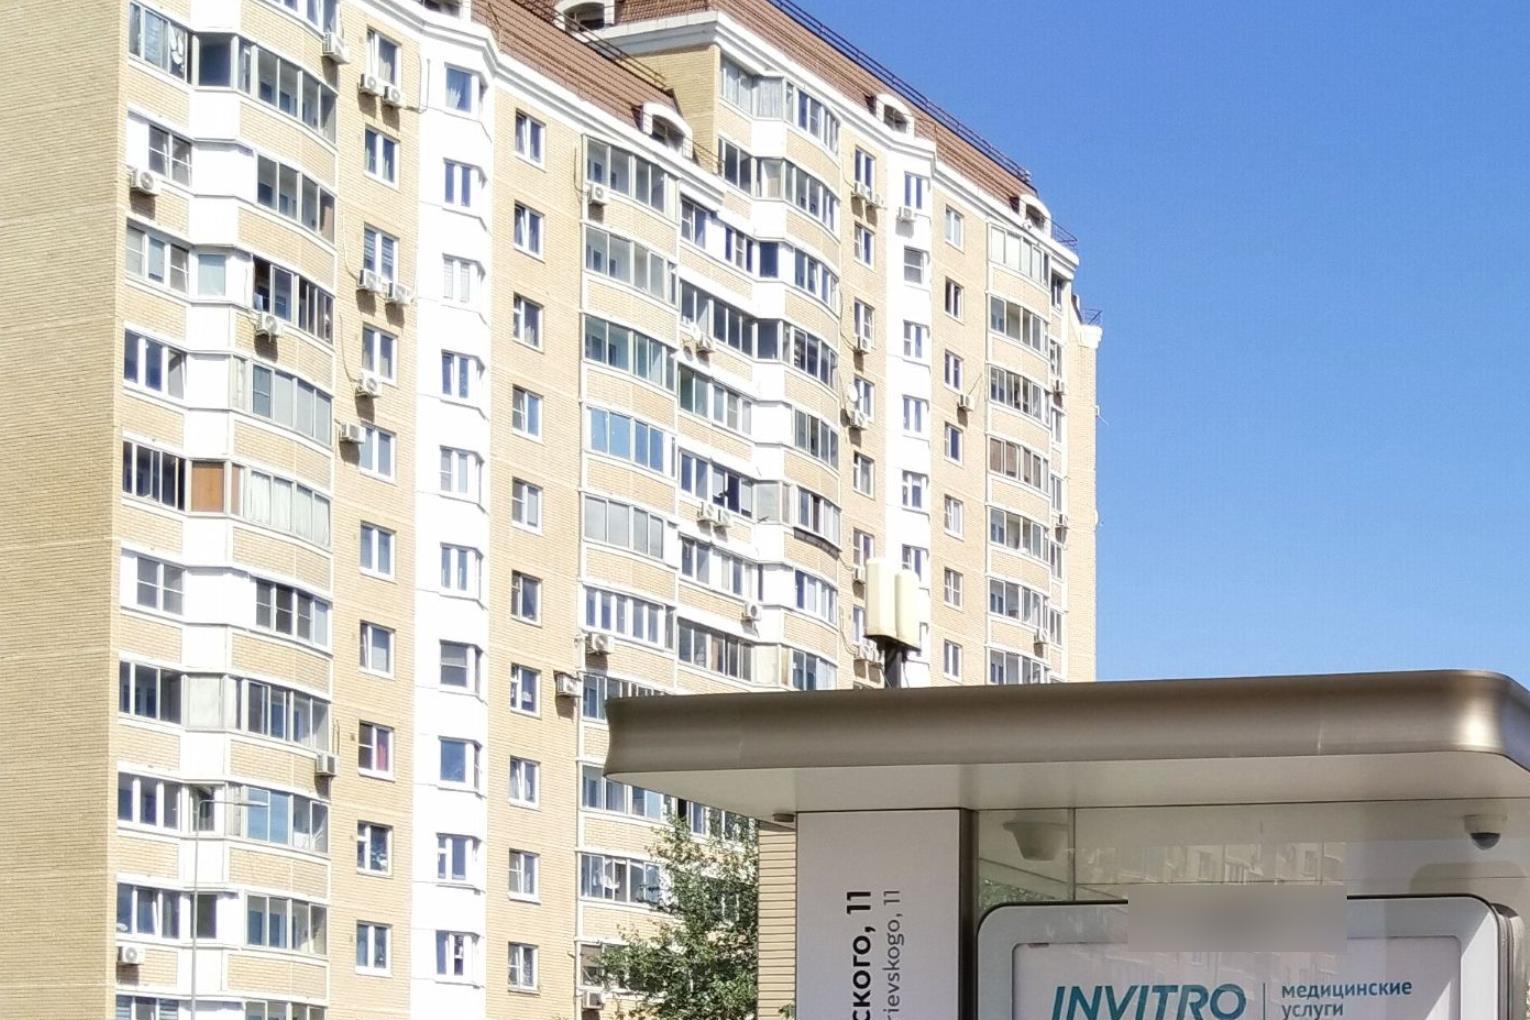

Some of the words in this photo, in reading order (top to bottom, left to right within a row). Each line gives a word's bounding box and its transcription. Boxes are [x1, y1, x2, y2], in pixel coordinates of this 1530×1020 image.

[847, 891, 871, 915] 11
[883, 890, 900, 906] 11
[1281, 980, 1413, 1000] медицинские
